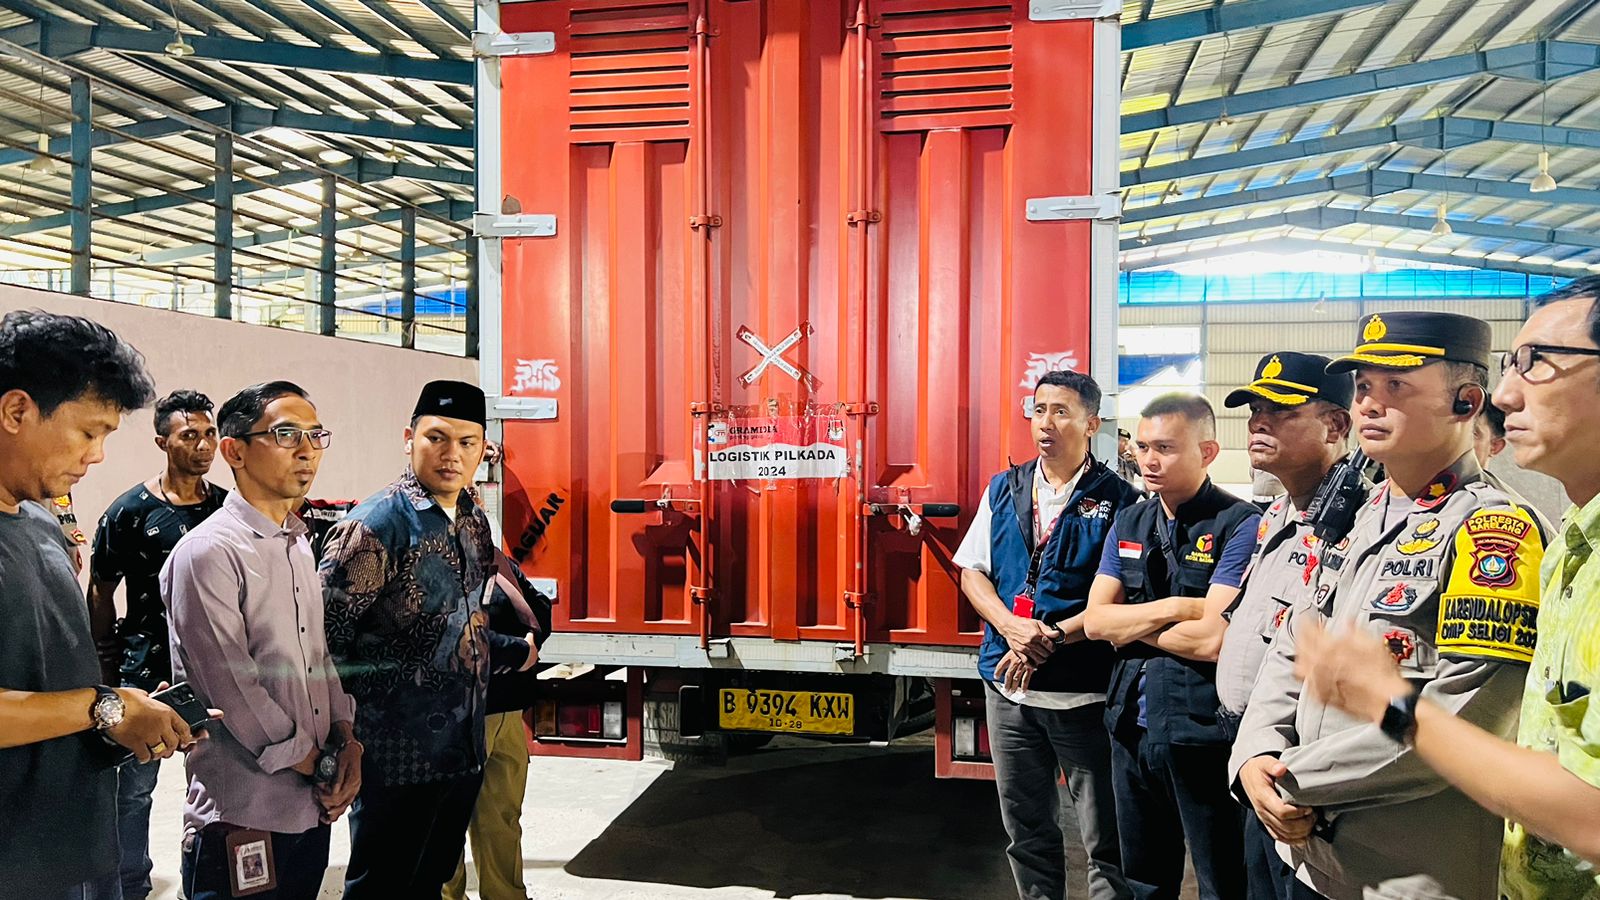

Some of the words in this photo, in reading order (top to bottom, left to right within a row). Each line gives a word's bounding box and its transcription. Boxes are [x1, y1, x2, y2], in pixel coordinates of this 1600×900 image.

[709, 450, 770, 462] LOGISTIK
[774, 449, 836, 461] PILKADA
[758, 466, 787, 477] 2024
[511, 492, 565, 564] AGUAR
[1468, 515, 1525, 531] POLRESTA
[1381, 558, 1433, 577] POLRI
[1467, 622, 1512, 643] SELIGI
[723, 691, 736, 714] B
[746, 693, 797, 717] 9394
[809, 694, 850, 719] KXW
